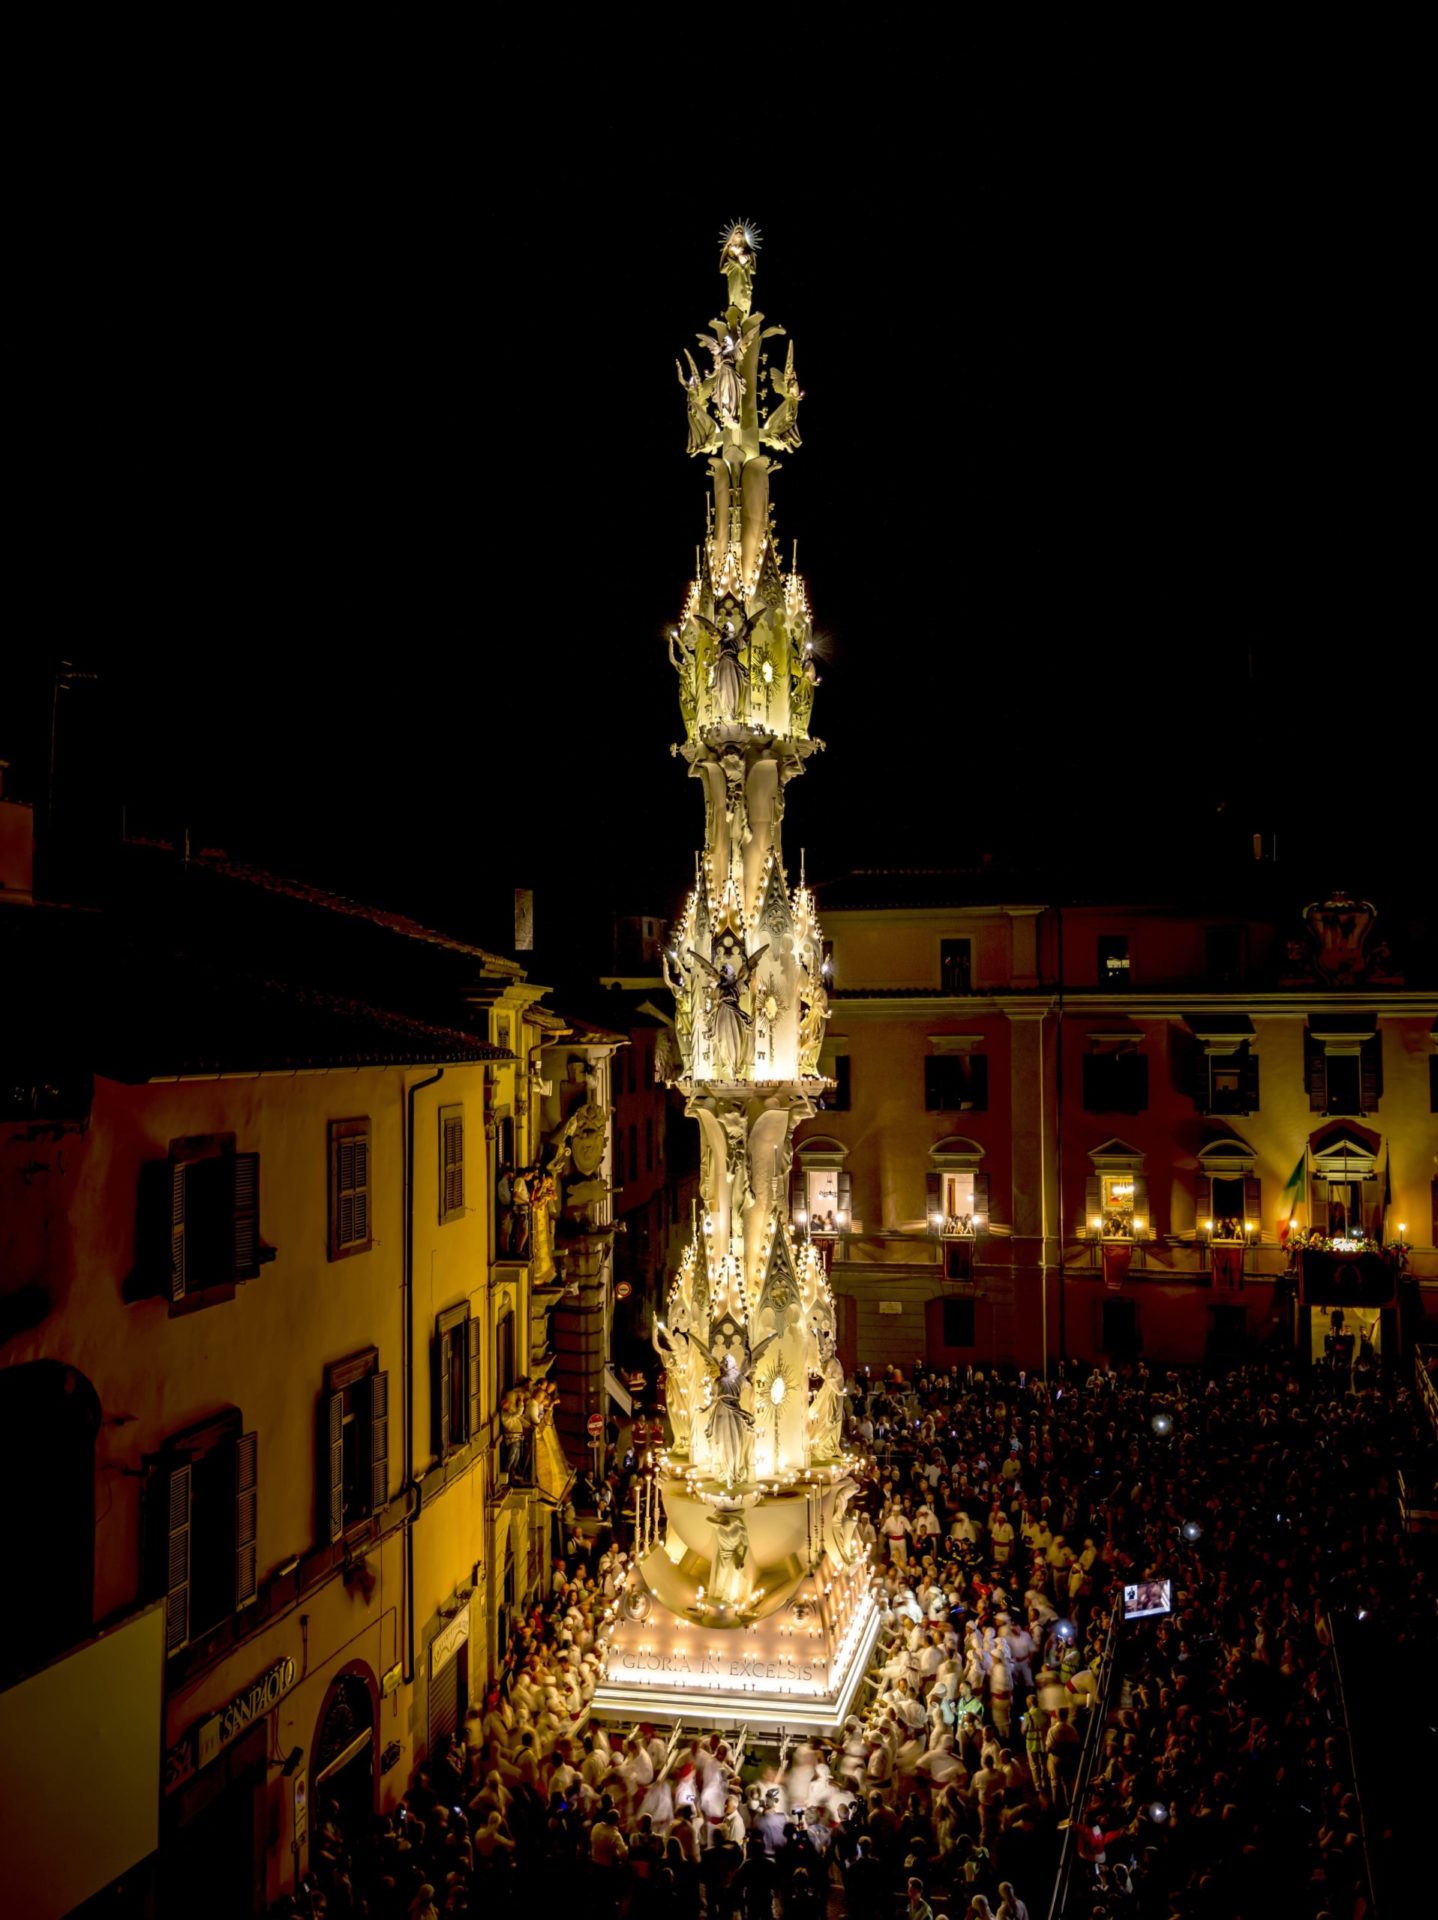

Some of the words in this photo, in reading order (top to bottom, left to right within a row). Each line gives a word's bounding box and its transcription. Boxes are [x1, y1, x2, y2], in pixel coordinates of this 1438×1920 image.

[622, 1653, 692, 1673] GLORIA
[700, 1659, 720, 1675] IN
[729, 1661, 813, 1682] EXCELSIS
[223, 1657, 297, 1740] SANPAOLO
